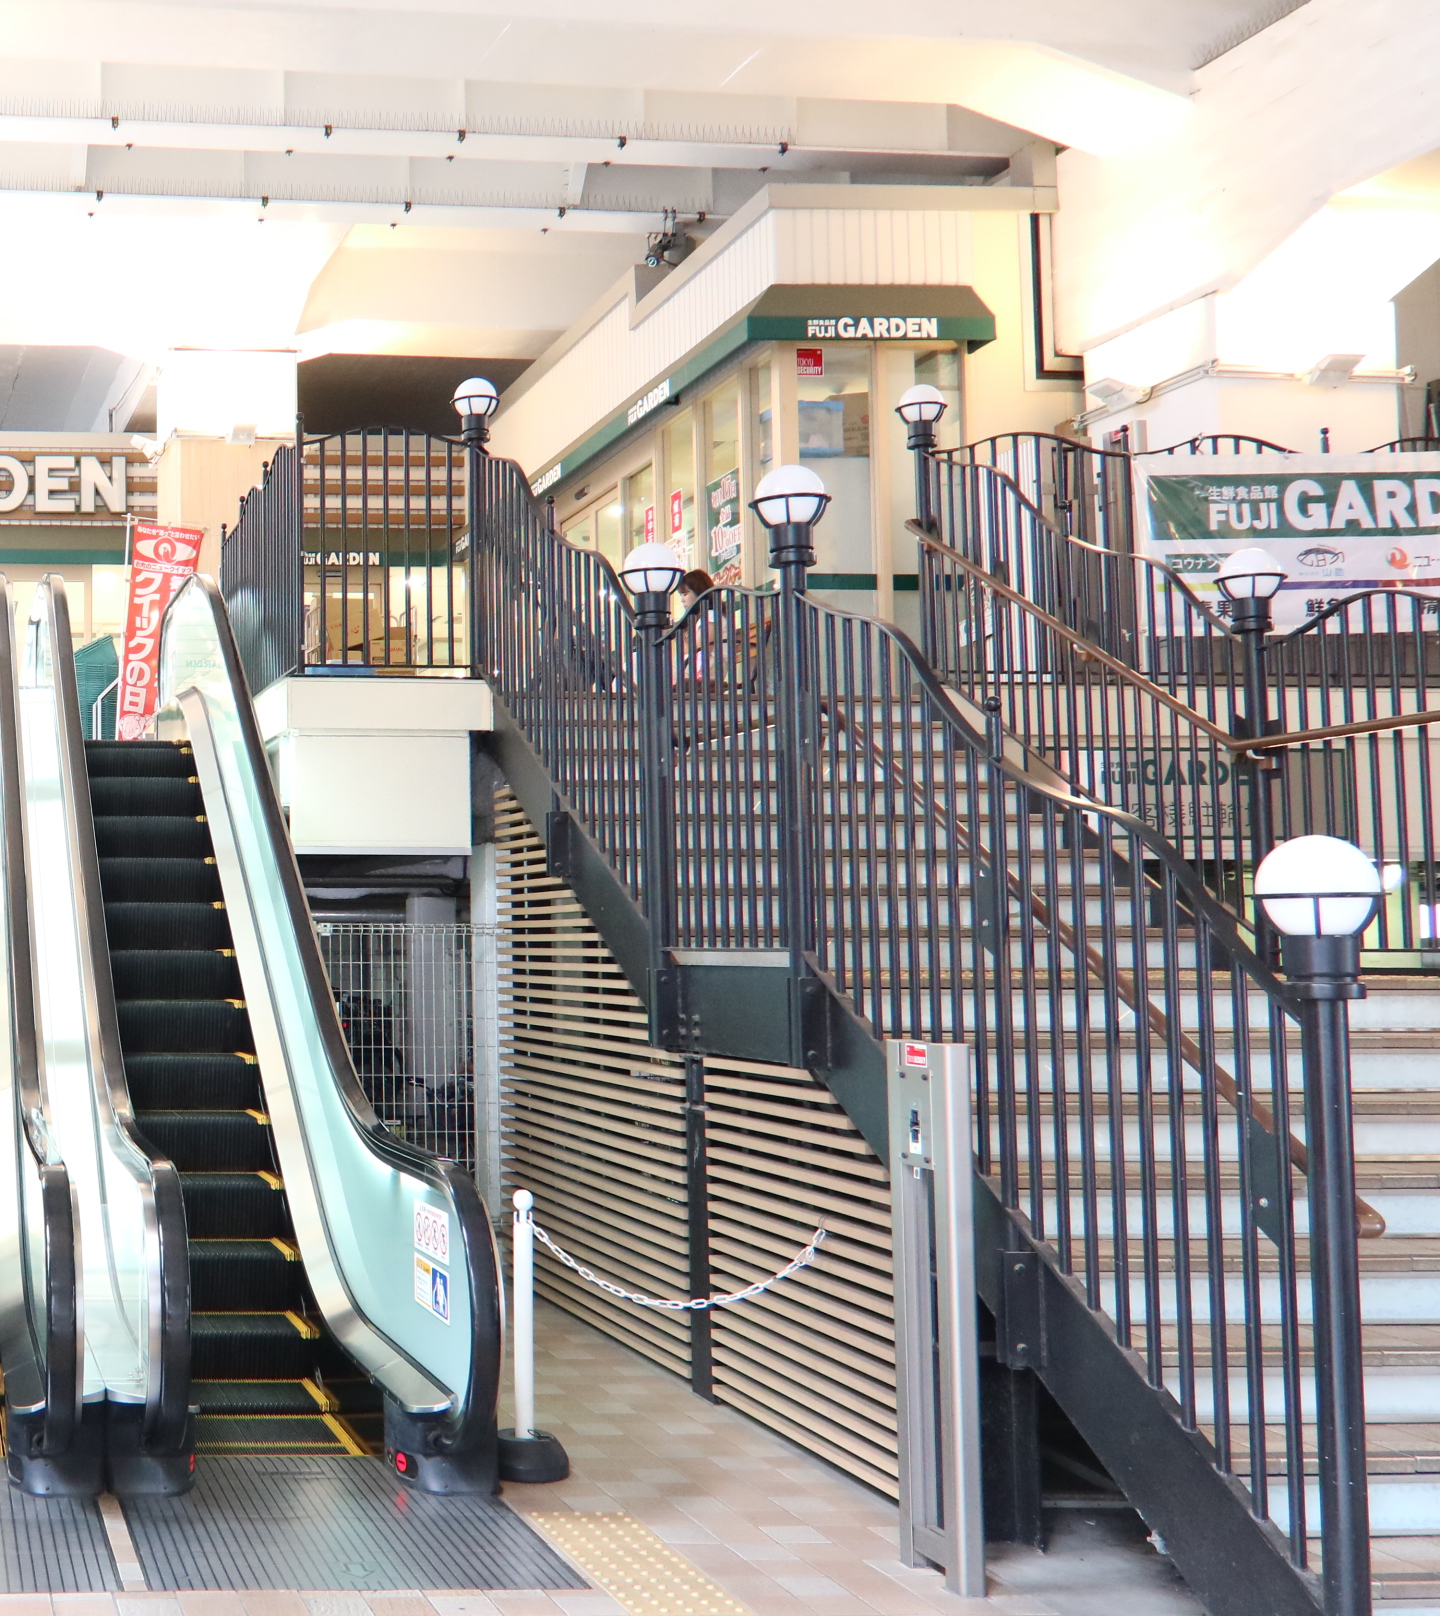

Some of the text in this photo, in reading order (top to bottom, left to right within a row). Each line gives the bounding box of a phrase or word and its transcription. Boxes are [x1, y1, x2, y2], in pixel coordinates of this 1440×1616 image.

[807, 317, 938, 338] FUJI GARDEN
[636, 377, 670, 420] GARDEN
[537, 462, 562, 494] GARDEN
[1208, 485, 1279, 500] 生鮮食品館
[1209, 502, 1279, 531] FUJI
[122, 571, 164, 714] クイックの日
